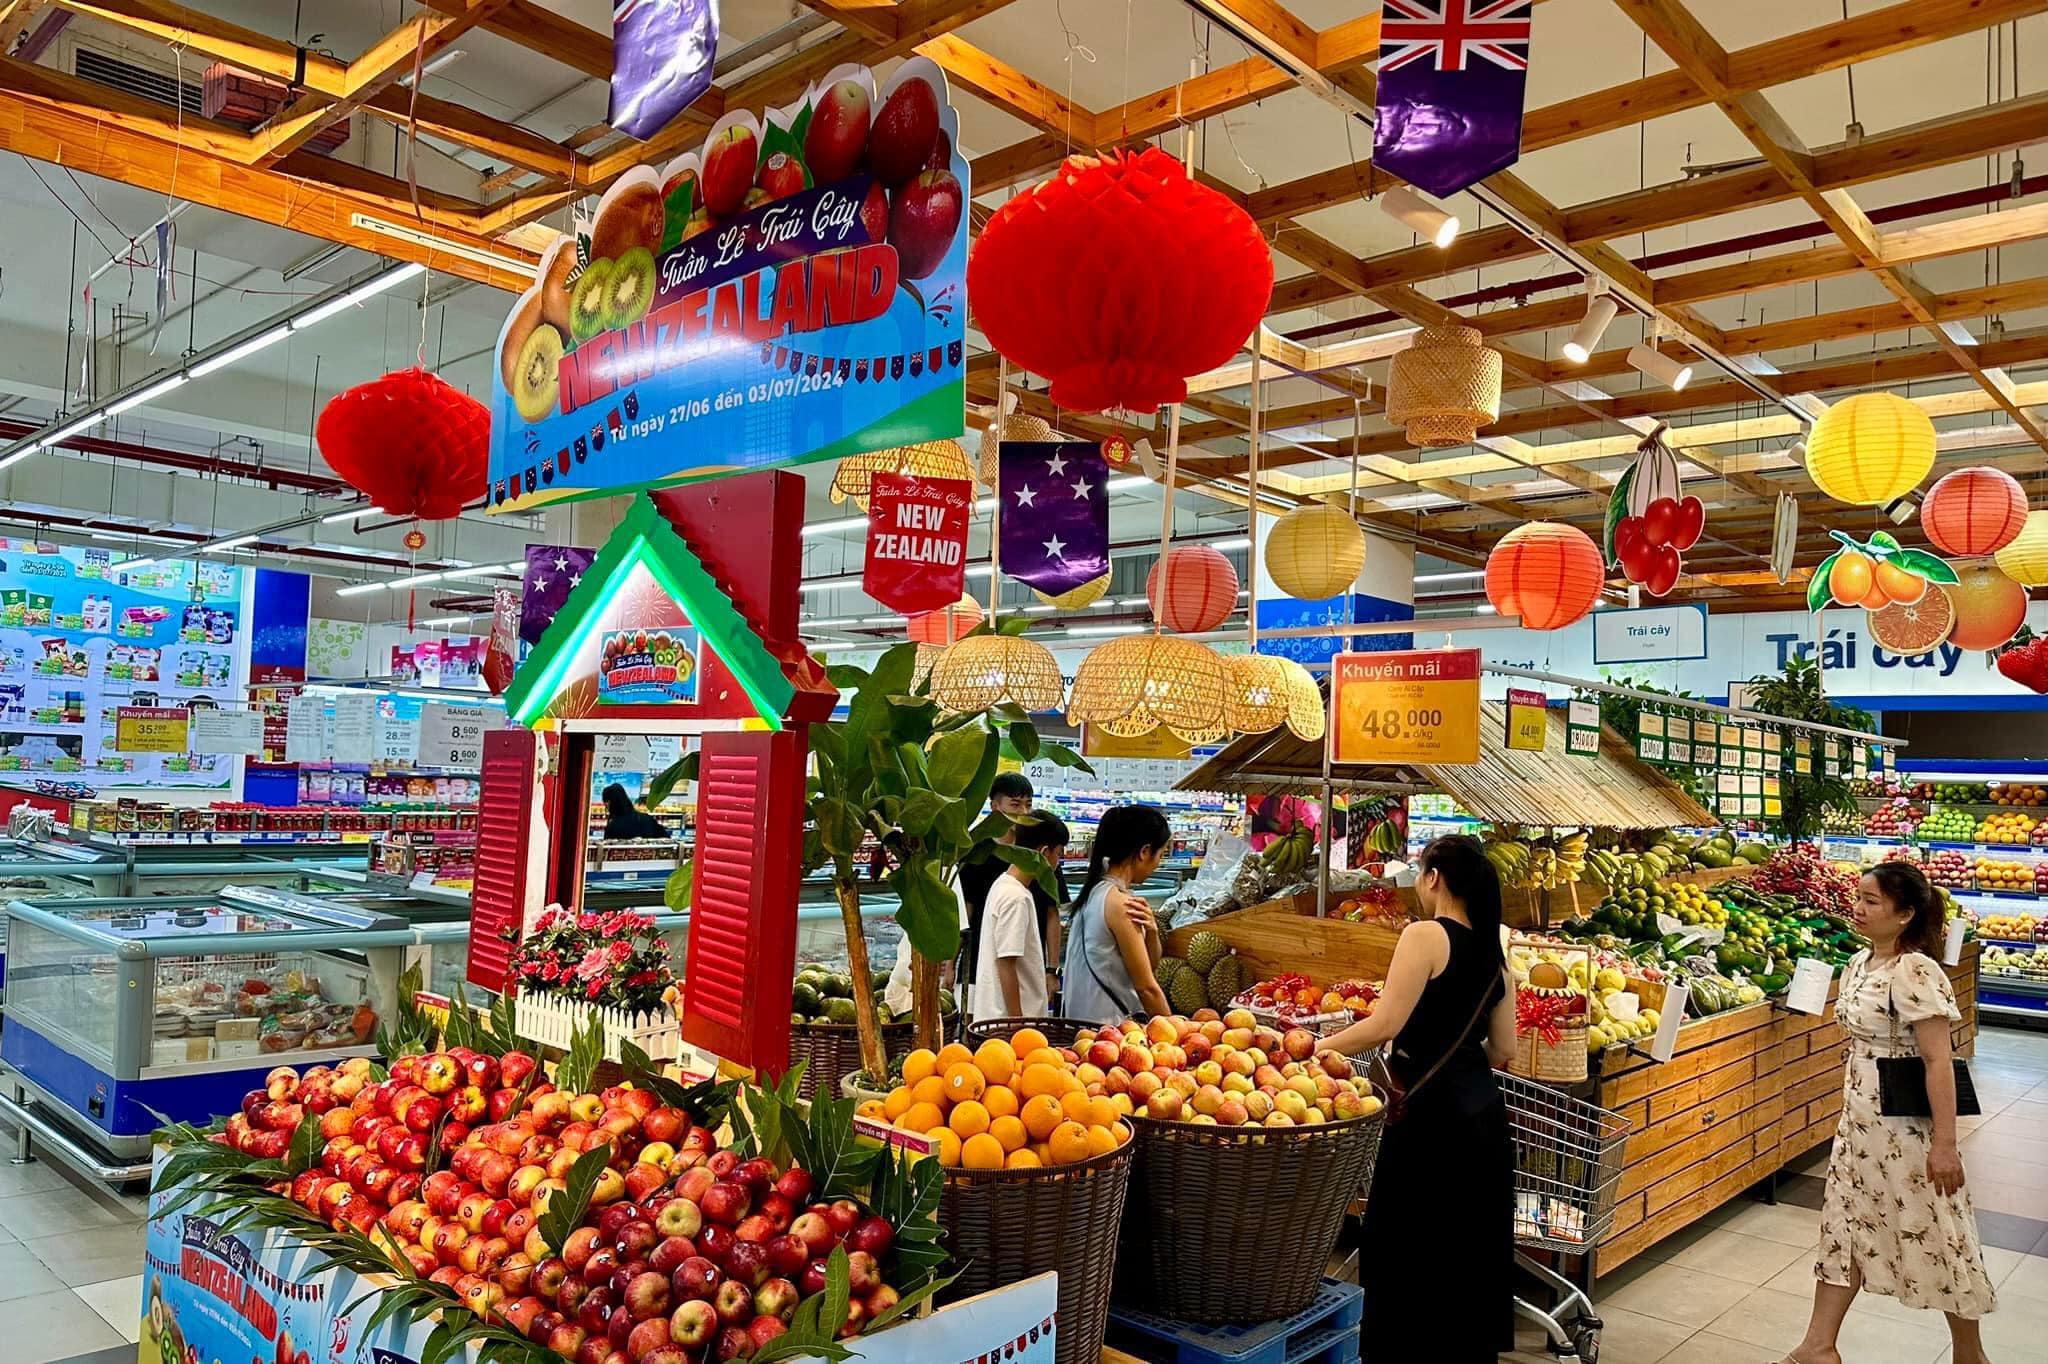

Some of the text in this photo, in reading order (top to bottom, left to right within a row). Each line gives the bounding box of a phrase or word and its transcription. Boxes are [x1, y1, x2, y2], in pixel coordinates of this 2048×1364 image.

[660, 190, 859, 294] Tuần Lễ Trái Cây
[610, 370, 844, 443] Từ ngày 27/06 đến 03/07/2024
[896, 503, 945, 532] NEW
[874, 533, 961, 566] ZEALAND
[1627, 624, 1671, 637] Trái cây
[1766, 629, 1856, 670] Trái
[1342, 660, 1440, 681] Khuyến mãi
